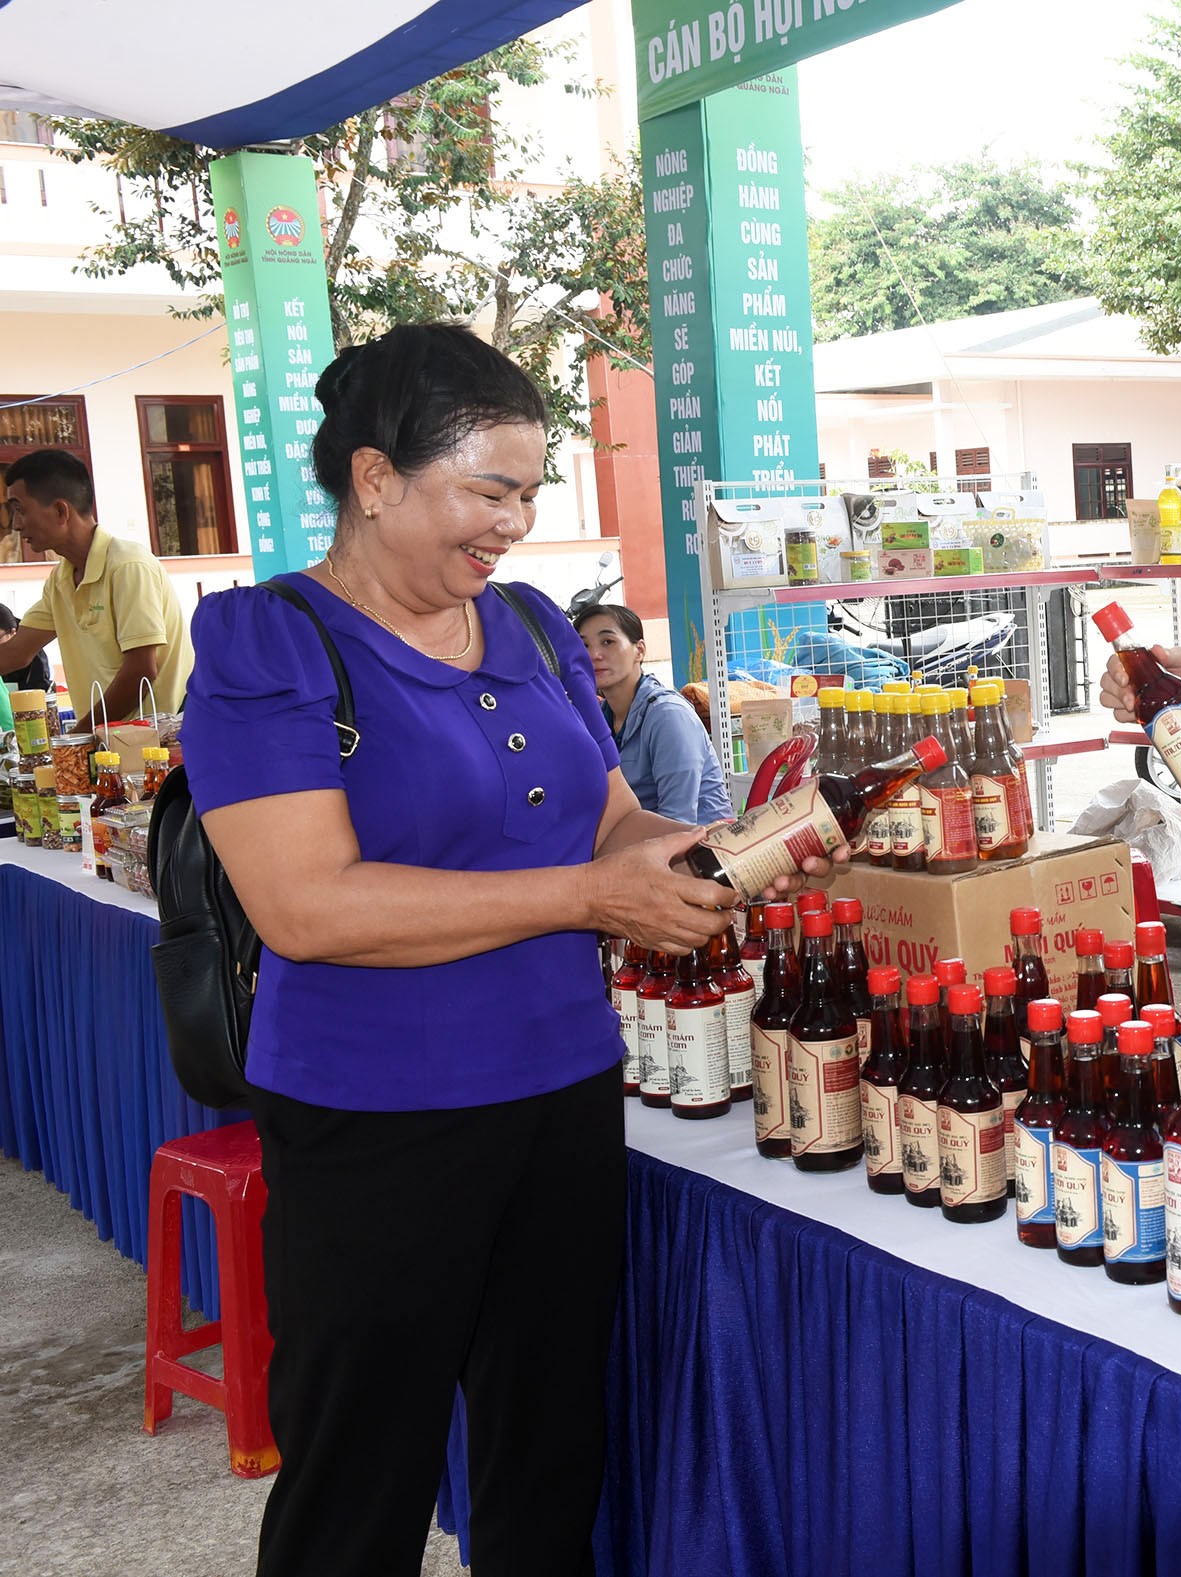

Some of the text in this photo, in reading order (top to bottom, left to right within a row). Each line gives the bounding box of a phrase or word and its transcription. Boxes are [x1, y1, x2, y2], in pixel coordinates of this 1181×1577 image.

[648, 20, 701, 83] CÁN
[709, 1, 745, 63] BỘ
[656, 148, 688, 177] NÔNG
[736, 142, 778, 175] ĐỒNG
[653, 182, 694, 214] NGHIỆP
[739, 181, 780, 210] HÀNH
[667, 222, 684, 247] ĐA
[740, 217, 781, 246] CÙNG
[662, 253, 693, 282] CHỨC
[747, 251, 779, 281] SẢN
[284, 297, 304, 317] KẾT
[664, 289, 695, 317] NĂNG
[743, 284, 786, 317] PHẨM
[287, 320, 308, 341] NỐI
[674, 325, 689, 351] SẼ
[730, 322, 802, 355] MIỀN NÚI,
[288, 344, 312, 364] SẢN
[672, 358, 695, 386] GÓP
[755, 355, 781, 387] KẾT
[278, 392, 309, 412] MIỀN
[670, 391, 701, 420] PHẦN
[757, 390, 783, 422] NỐI
[673, 424, 702, 454] GIẢM
[753, 428, 790, 457] PHÁT
[752, 460, 795, 492] TRIỂN
[888, 905, 913, 927] MẮM
[897, 937, 939, 977] QUÝ
